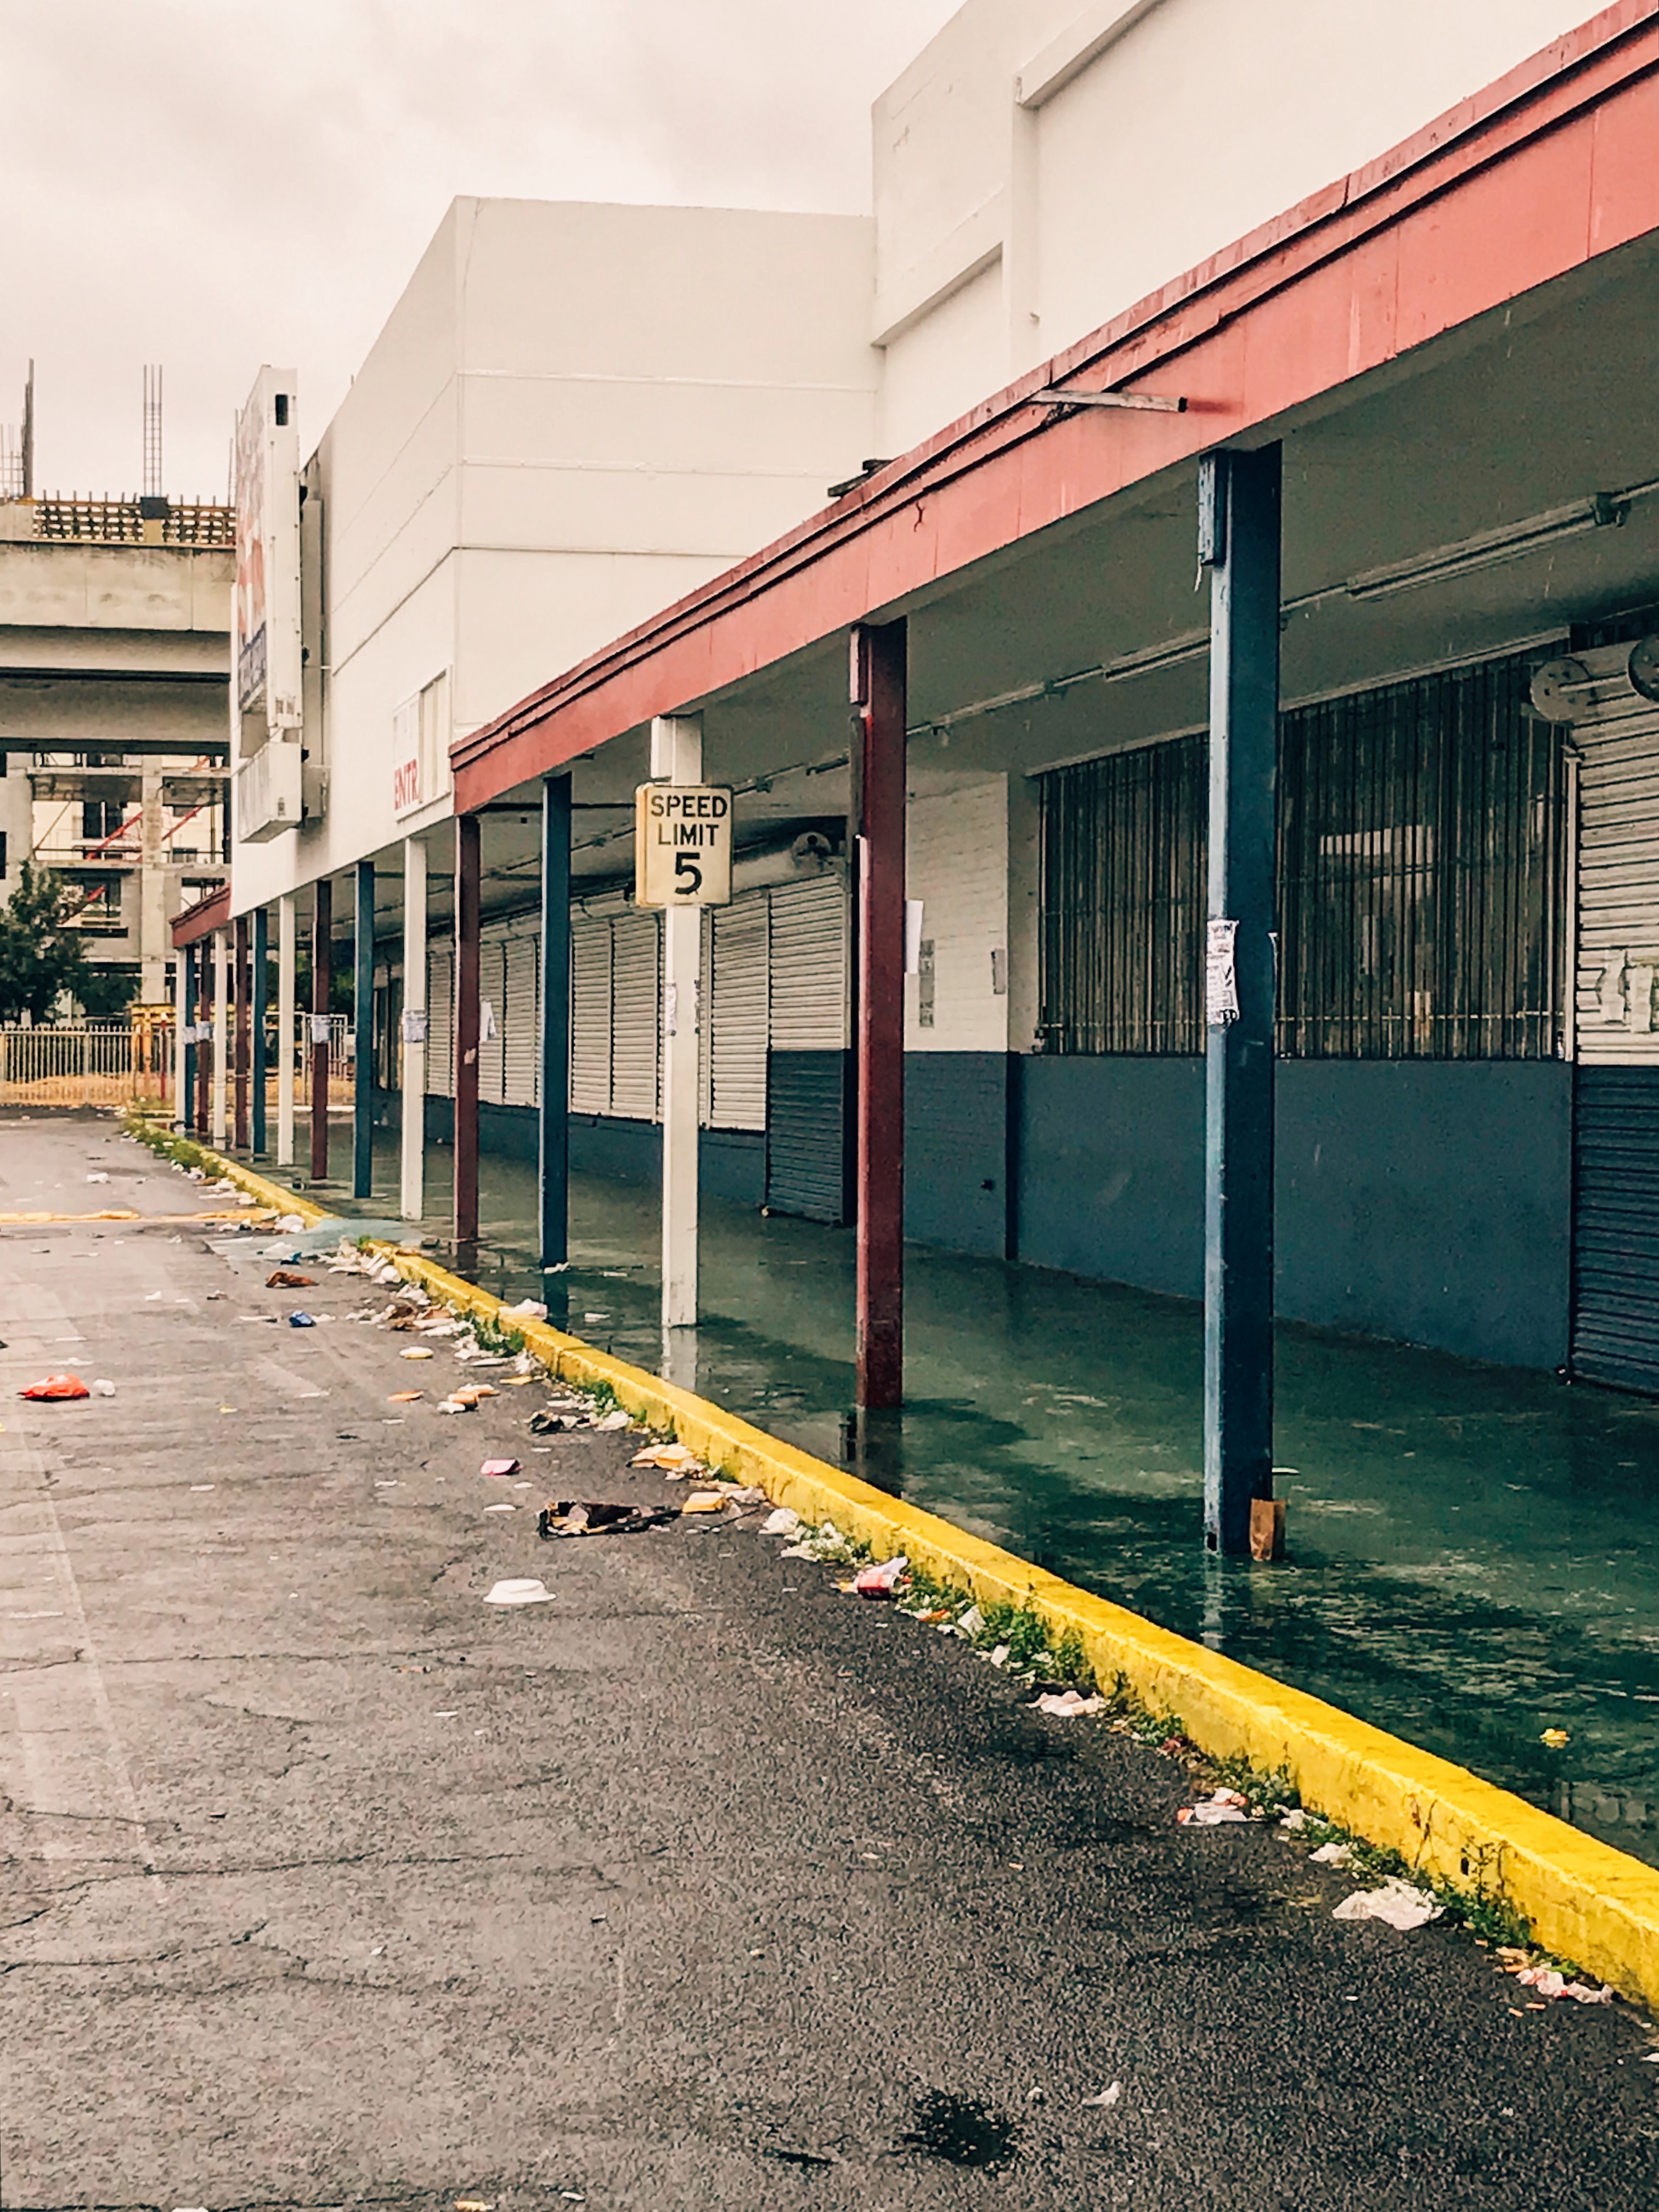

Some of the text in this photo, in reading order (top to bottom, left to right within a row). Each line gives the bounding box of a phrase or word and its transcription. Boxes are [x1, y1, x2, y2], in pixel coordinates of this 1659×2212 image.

[651, 795, 727, 817] SPEED
[658, 823, 719, 846] LIMIT
[675, 851, 702, 895] 5
